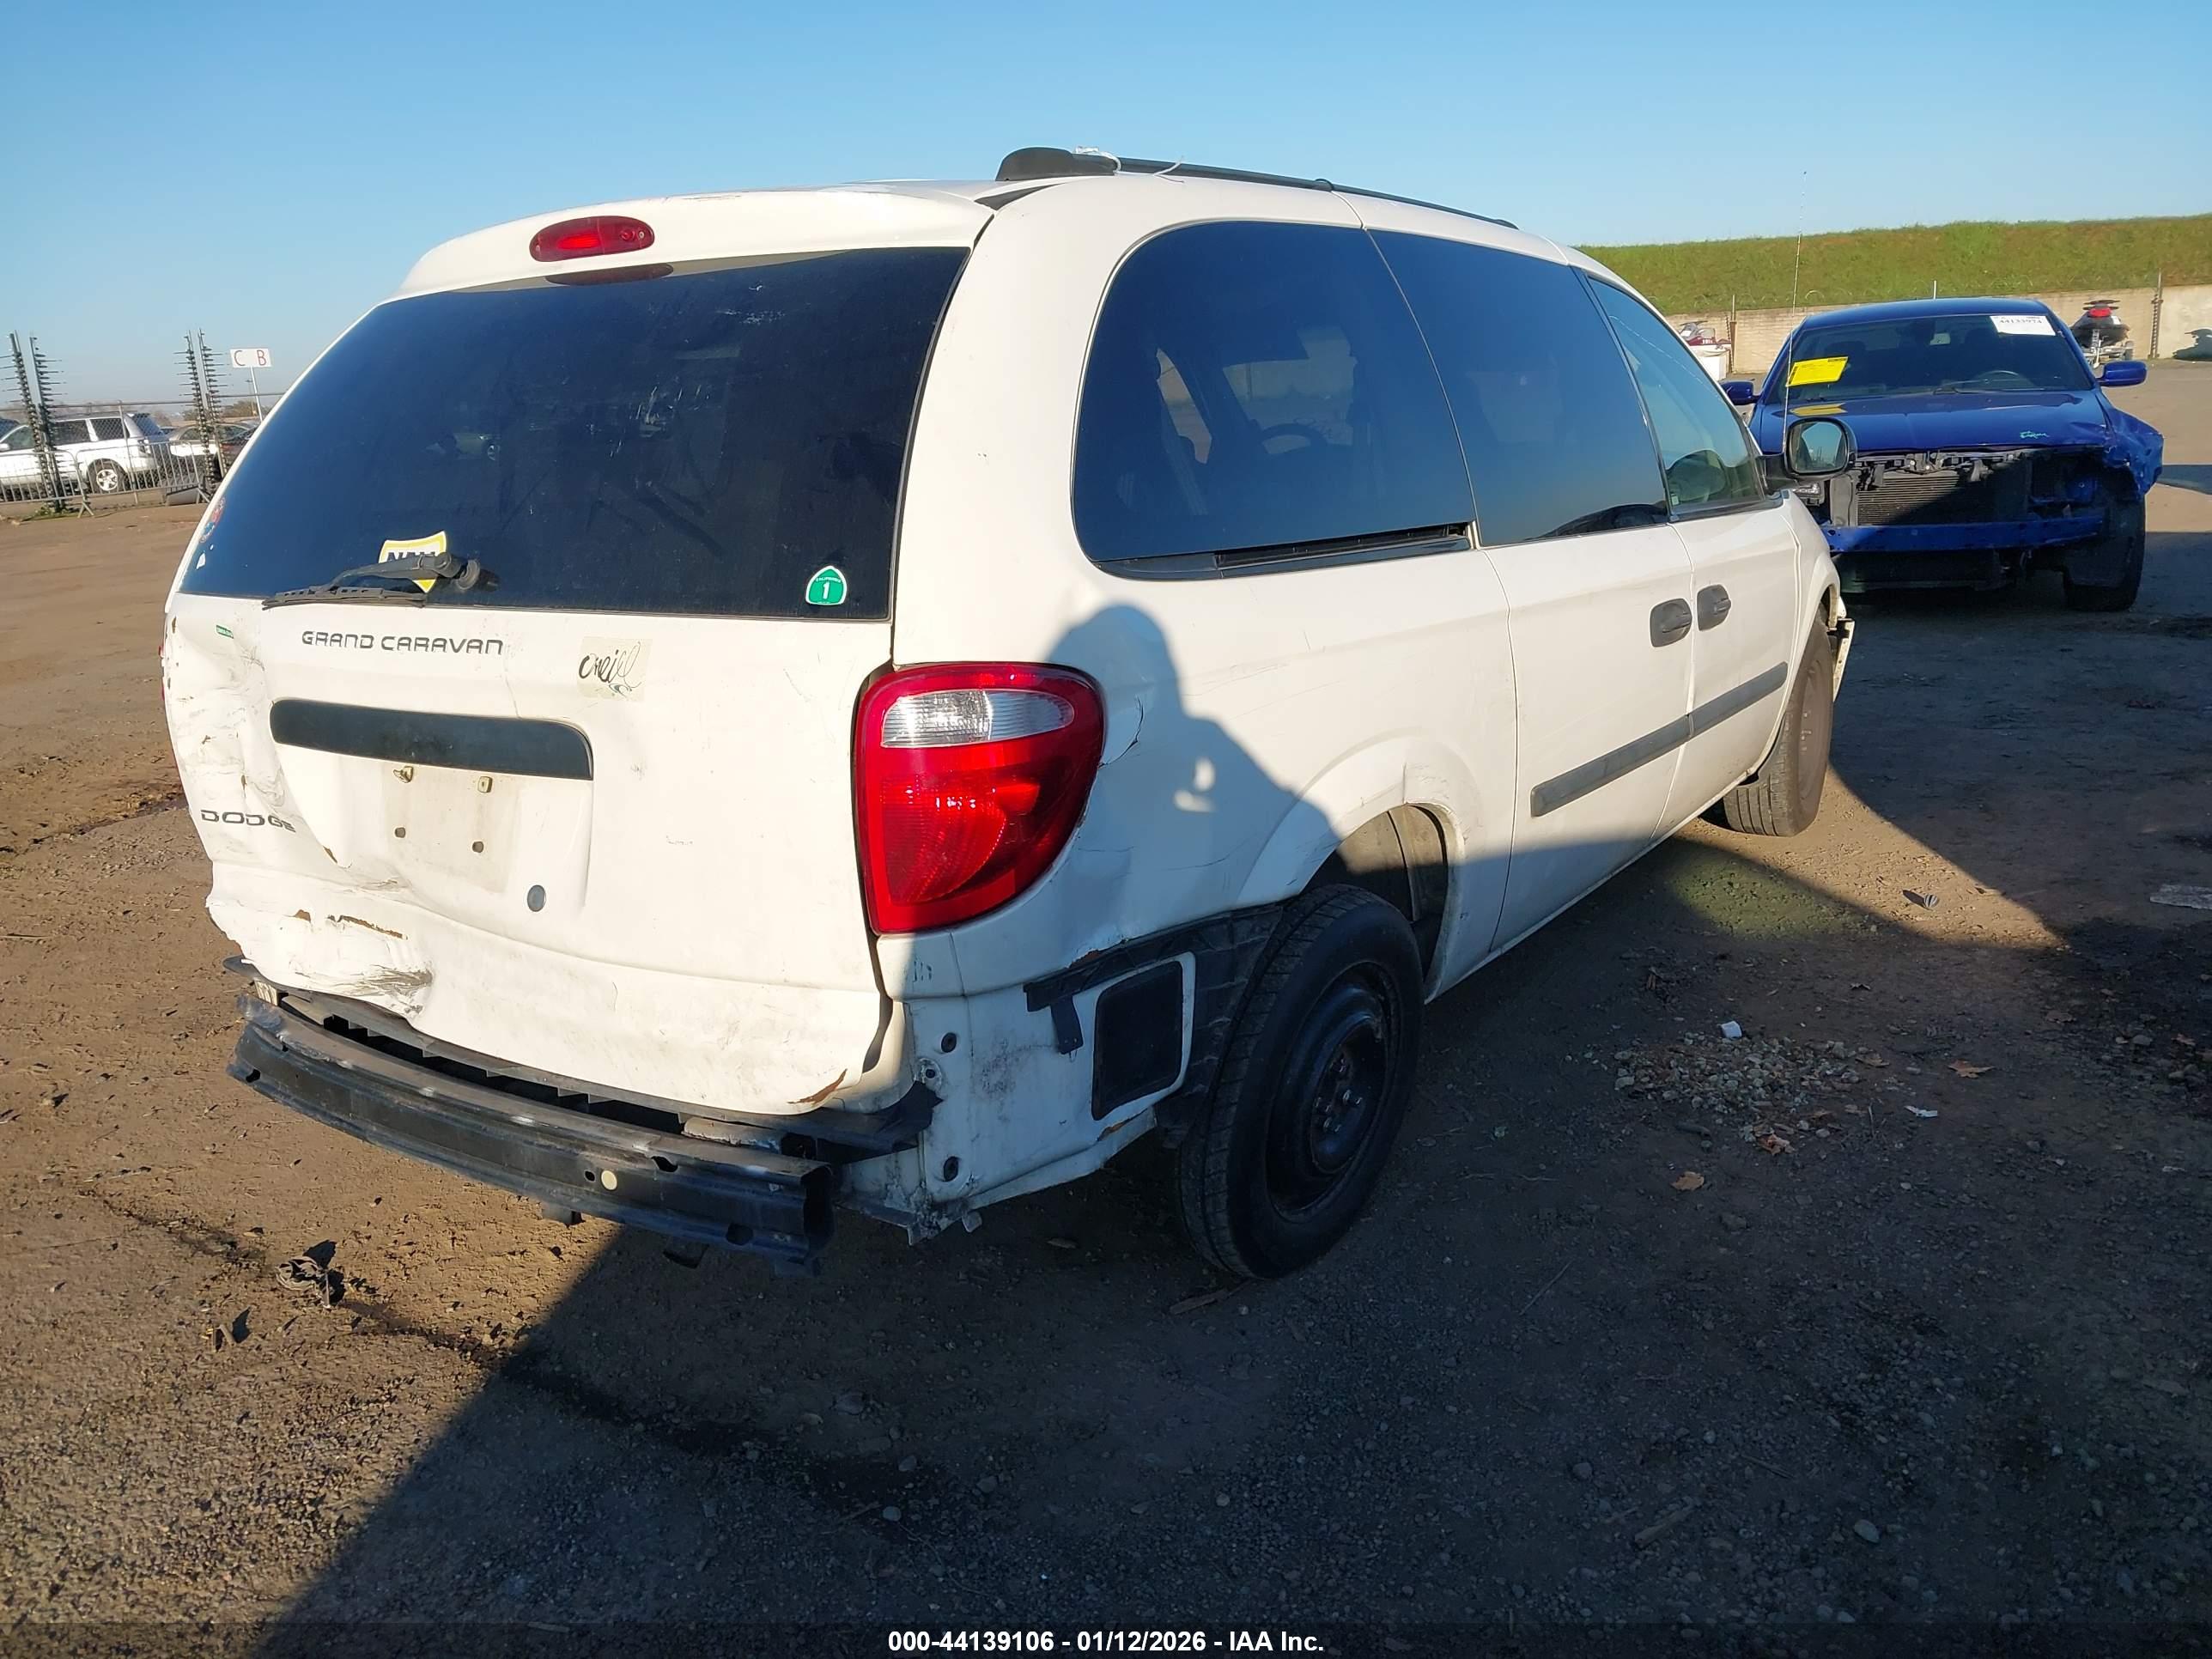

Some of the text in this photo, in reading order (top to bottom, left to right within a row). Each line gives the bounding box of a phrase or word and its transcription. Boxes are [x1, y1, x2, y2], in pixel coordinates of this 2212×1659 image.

[234, 349, 267, 366] C B
[823, 580, 830, 599] 1
[301, 630, 504, 655] GRAND CARAVAN
[200, 809, 296, 833] DODGE
